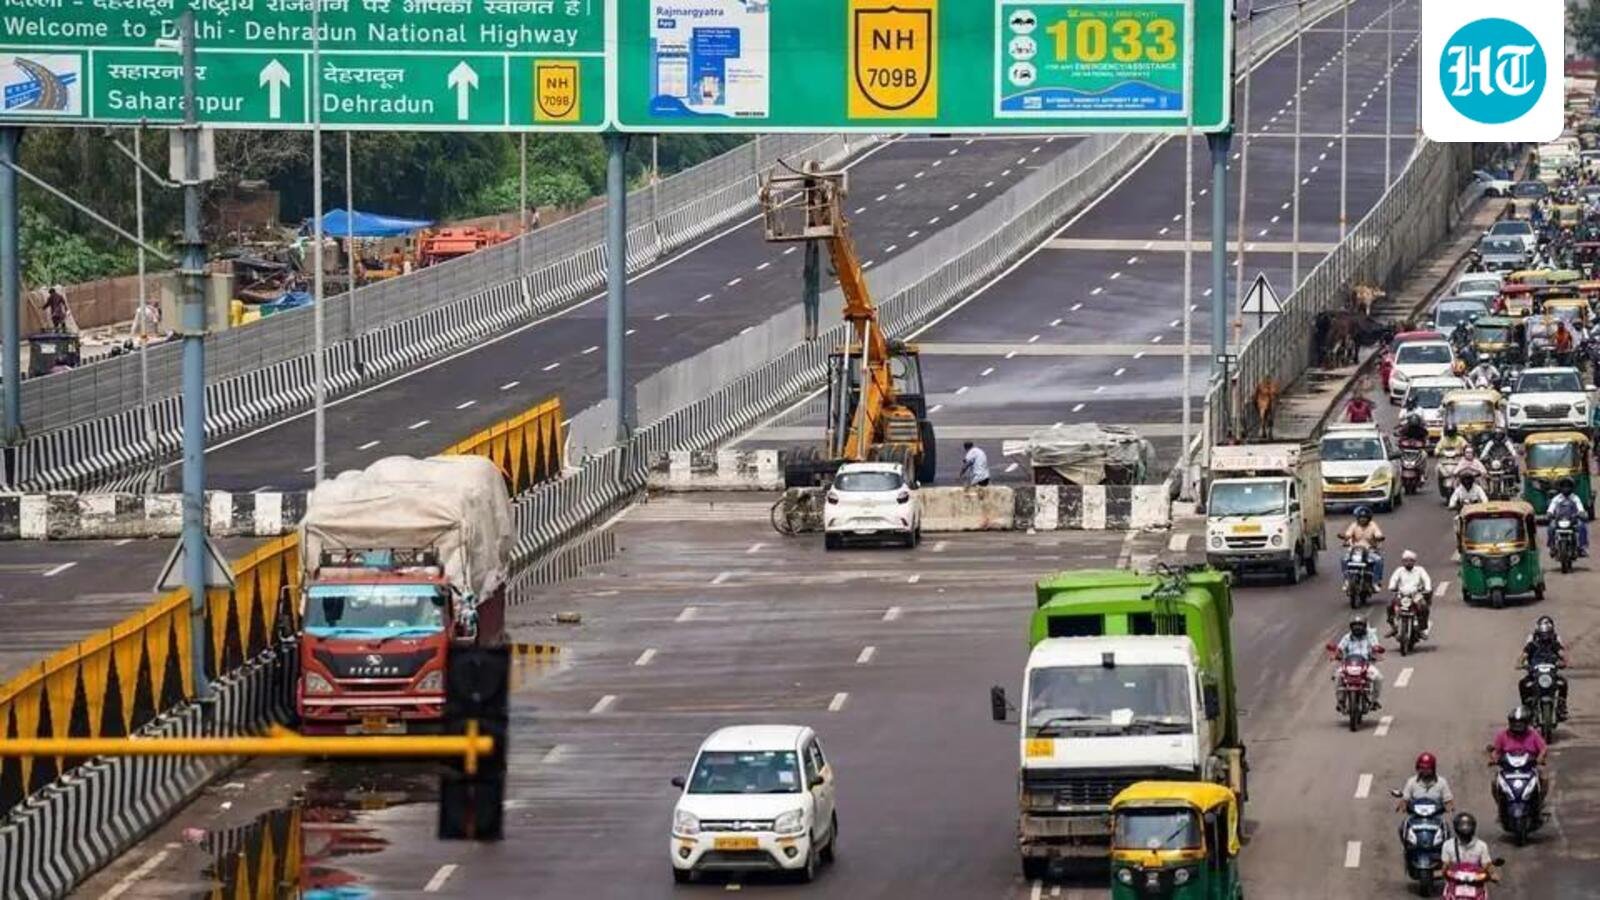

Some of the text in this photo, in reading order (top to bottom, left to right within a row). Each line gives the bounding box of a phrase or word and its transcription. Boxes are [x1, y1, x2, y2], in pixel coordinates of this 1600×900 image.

[93, 0, 174, 16] दहरादून
[363, 0, 391, 13] पर
[403, 0, 471, 14] आपका
[484, 0, 553, 14] स्वागत
[656, 7, 725, 18] Rajmargyatra
[4, 17, 107, 37] Welcome
[123, 19, 146, 37] to
[161, 20, 222, 39] Dlhi
[246, 21, 356, 41] Dehradun
[369, 23, 466, 42] National
[480, 24, 578, 47] Highway
[873, 29, 914, 50] NH
[1045, 19, 1176, 62] 1033
[107, 65, 207, 80] सहारनर
[323, 62, 404, 88] देहरादून
[867, 68, 917, 87] 709B
[546, 78, 568, 89] NH
[323, 93, 434, 113] Dehradun
[544, 96, 569, 106] 709B
[350, 666, 400, 675] EICHER
